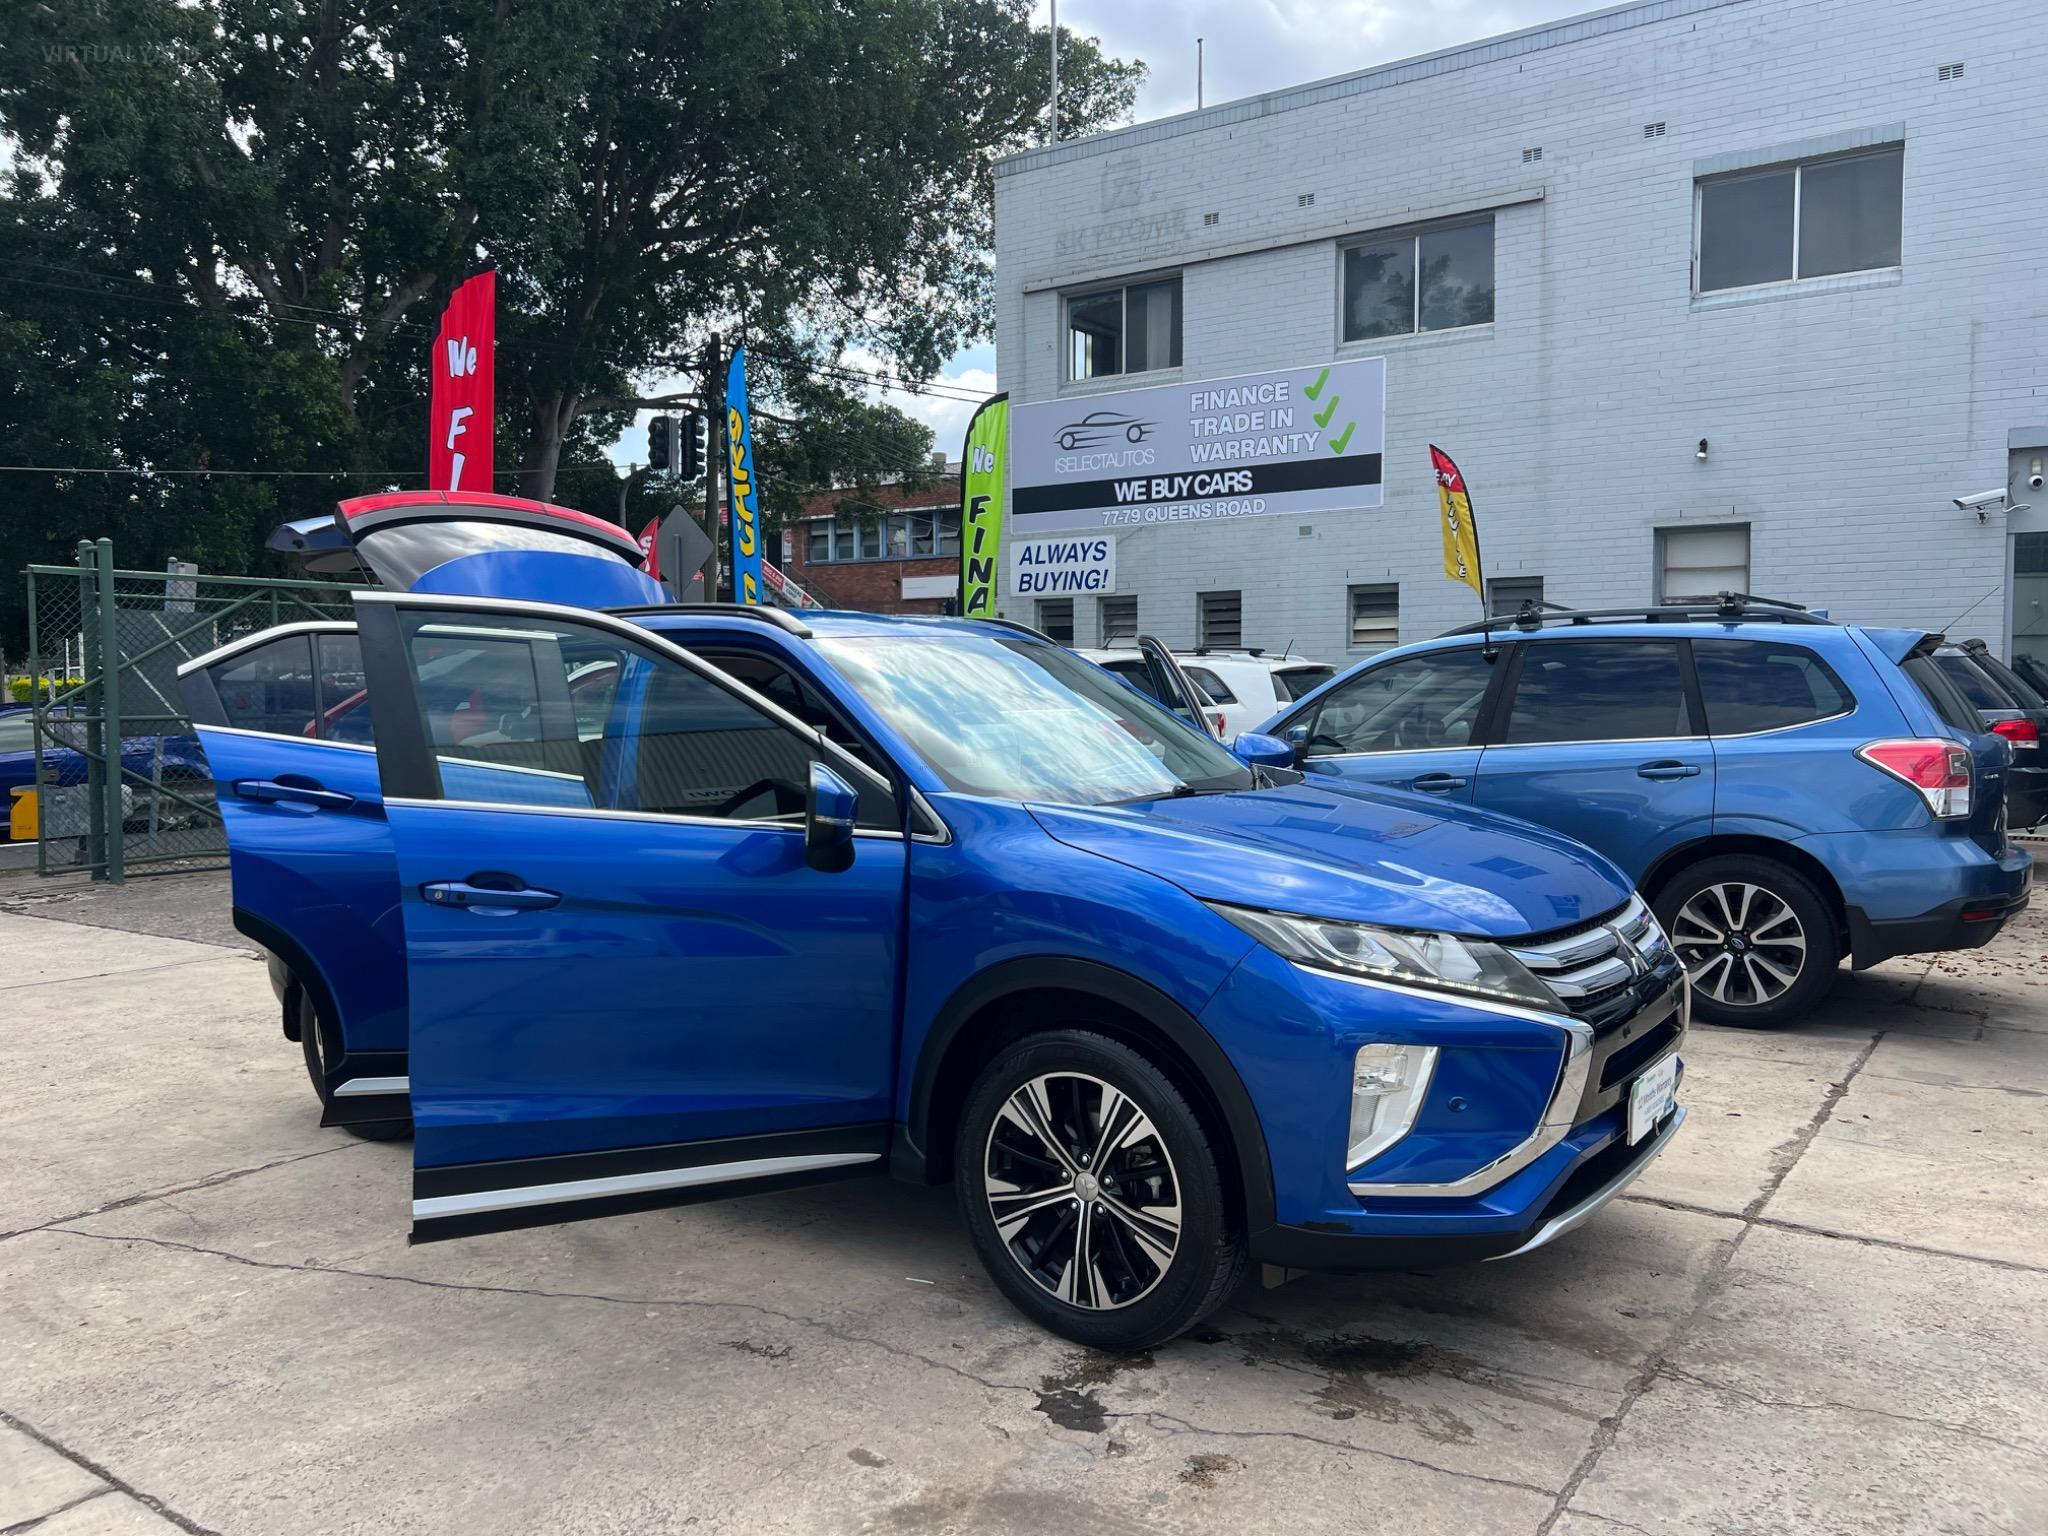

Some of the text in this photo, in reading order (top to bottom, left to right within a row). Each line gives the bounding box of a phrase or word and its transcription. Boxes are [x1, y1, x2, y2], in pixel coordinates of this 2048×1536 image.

[447, 335, 477, 378] We
[1190, 381, 1290, 413] FINANCE
[1190, 407, 1294, 438] TRADE IN
[971, 444, 994, 474] We
[1190, 430, 1321, 463] WARRANTY
[1114, 470, 1253, 502] WE BUY CARS
[1102, 498, 1267, 525] 77-79 QUEENS ROAD
[1019, 540, 1108, 566] ALWAYS
[1018, 568, 1109, 593] BUYING!
